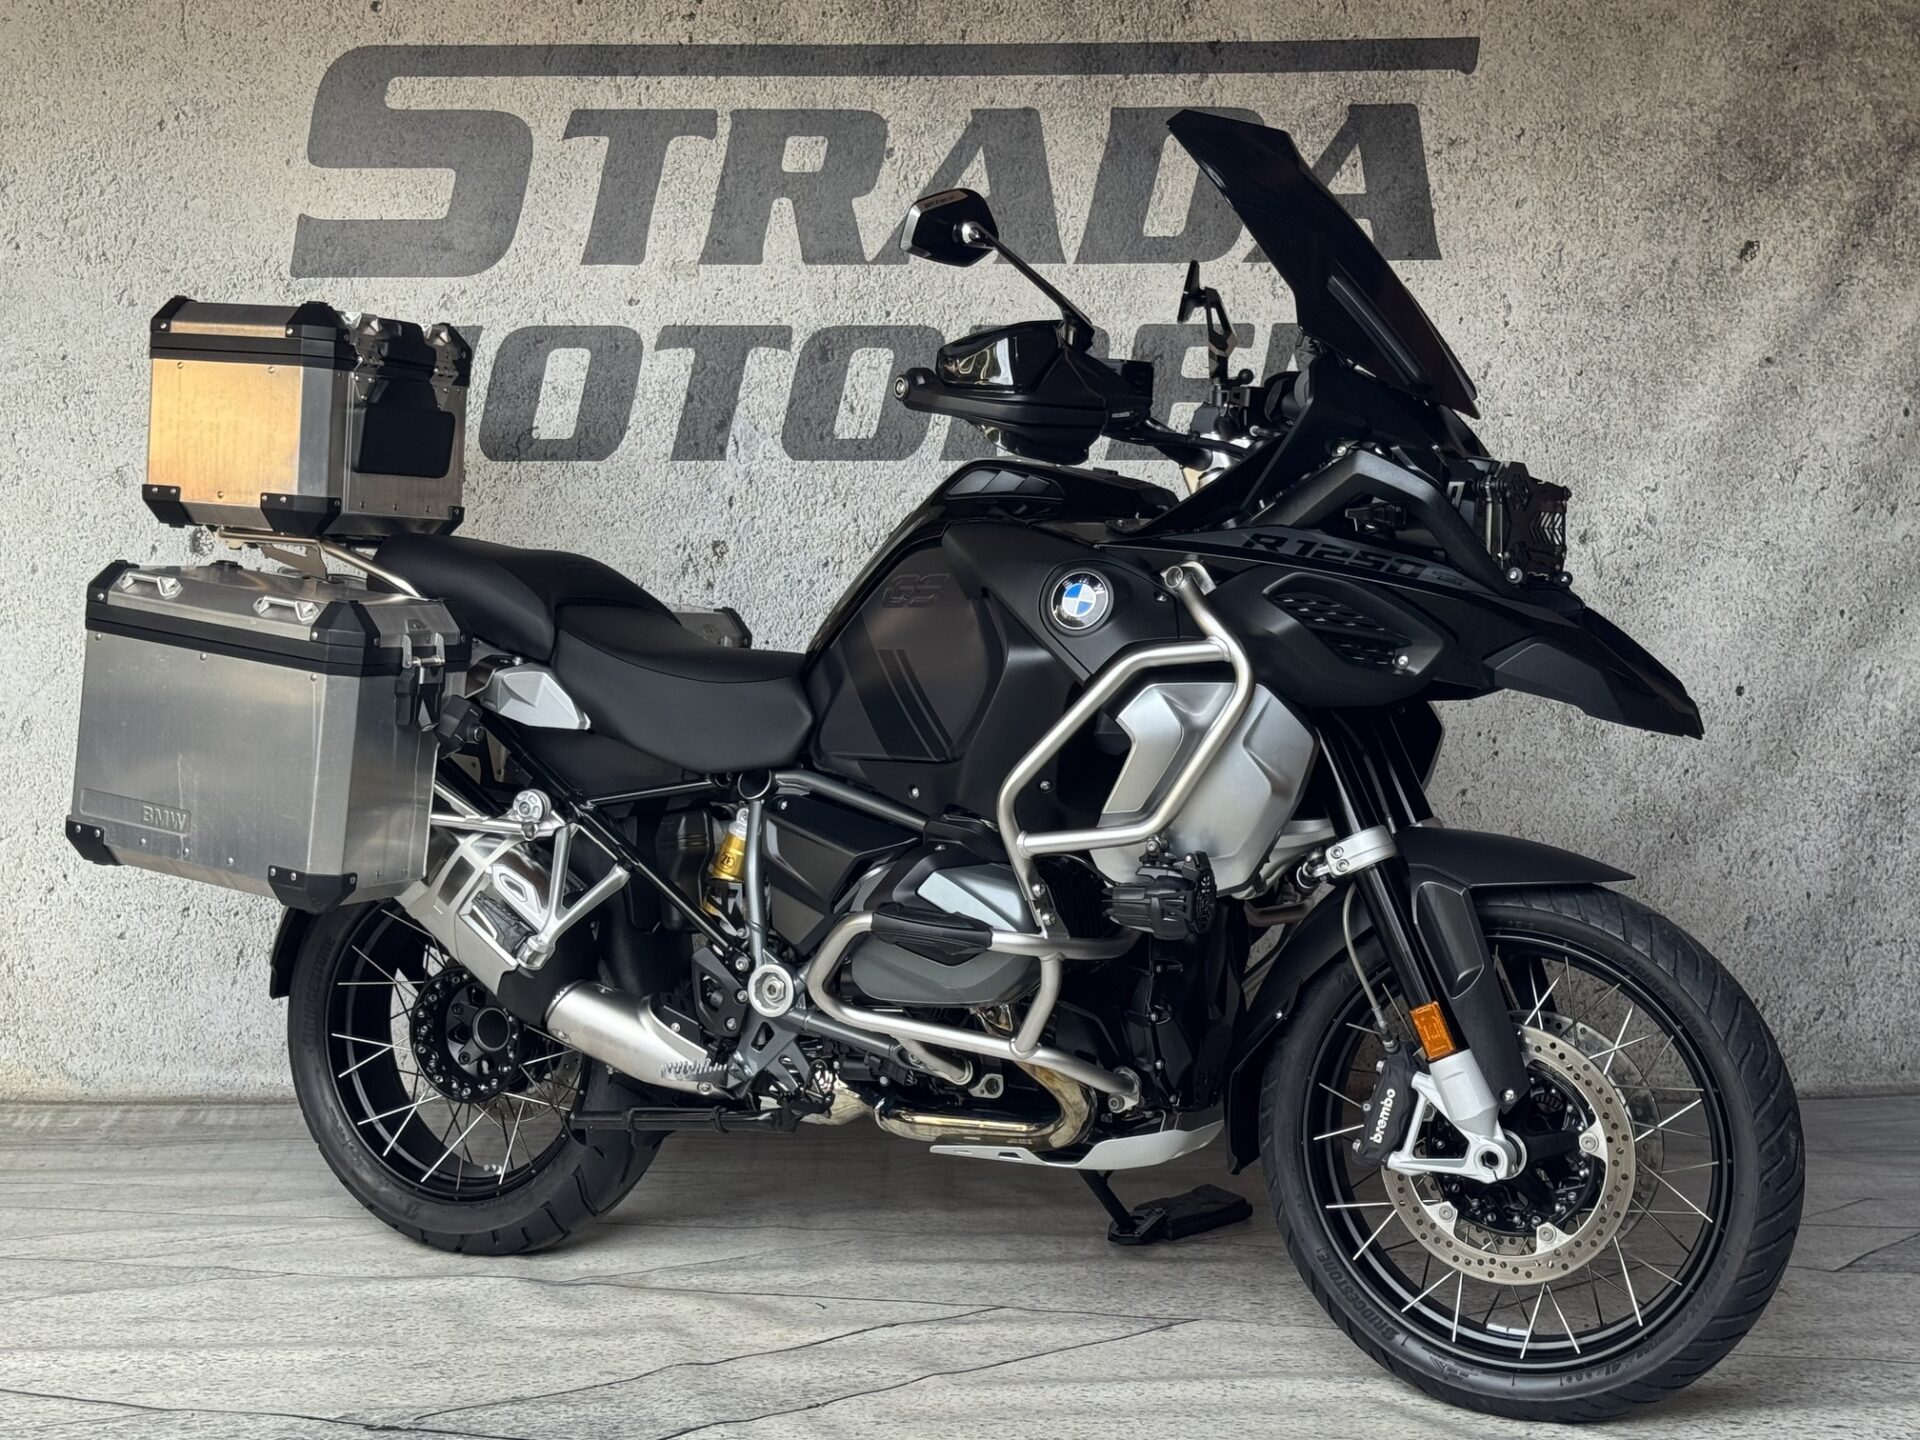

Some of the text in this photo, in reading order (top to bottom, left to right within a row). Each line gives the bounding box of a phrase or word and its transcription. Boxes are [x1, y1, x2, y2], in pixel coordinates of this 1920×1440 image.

[290, 37, 1480, 278] STRADA
[143, 805, 187, 832] BMW
[1370, 1088, 1396, 1144] brembo
[1316, 1248, 1401, 1341] BRIDGESTONE
